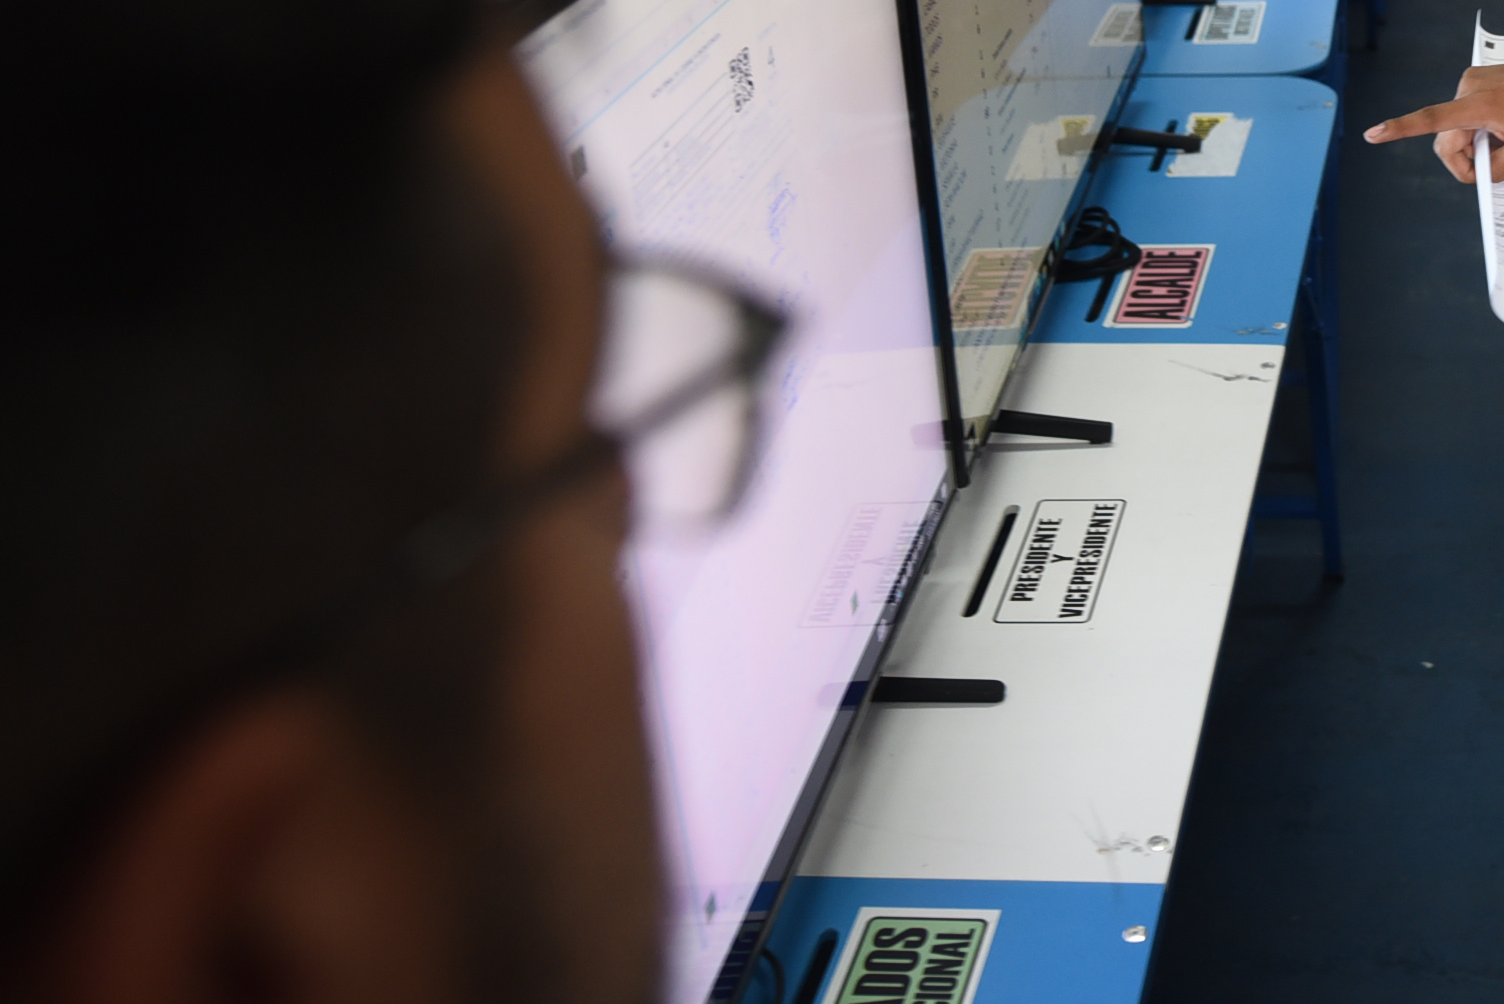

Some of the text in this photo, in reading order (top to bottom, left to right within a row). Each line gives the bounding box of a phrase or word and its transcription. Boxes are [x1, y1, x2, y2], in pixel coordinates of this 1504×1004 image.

[1123, 251, 1203, 320] ALCALDE
[1009, 518, 1063, 601] PRESIDENTE
[1050, 554, 1075, 564] Y
[1057, 503, 1118, 618] VICEPRESIDENTE
[848, 927, 929, 1004] DOS
[913, 927, 977, 1004] IONAL
